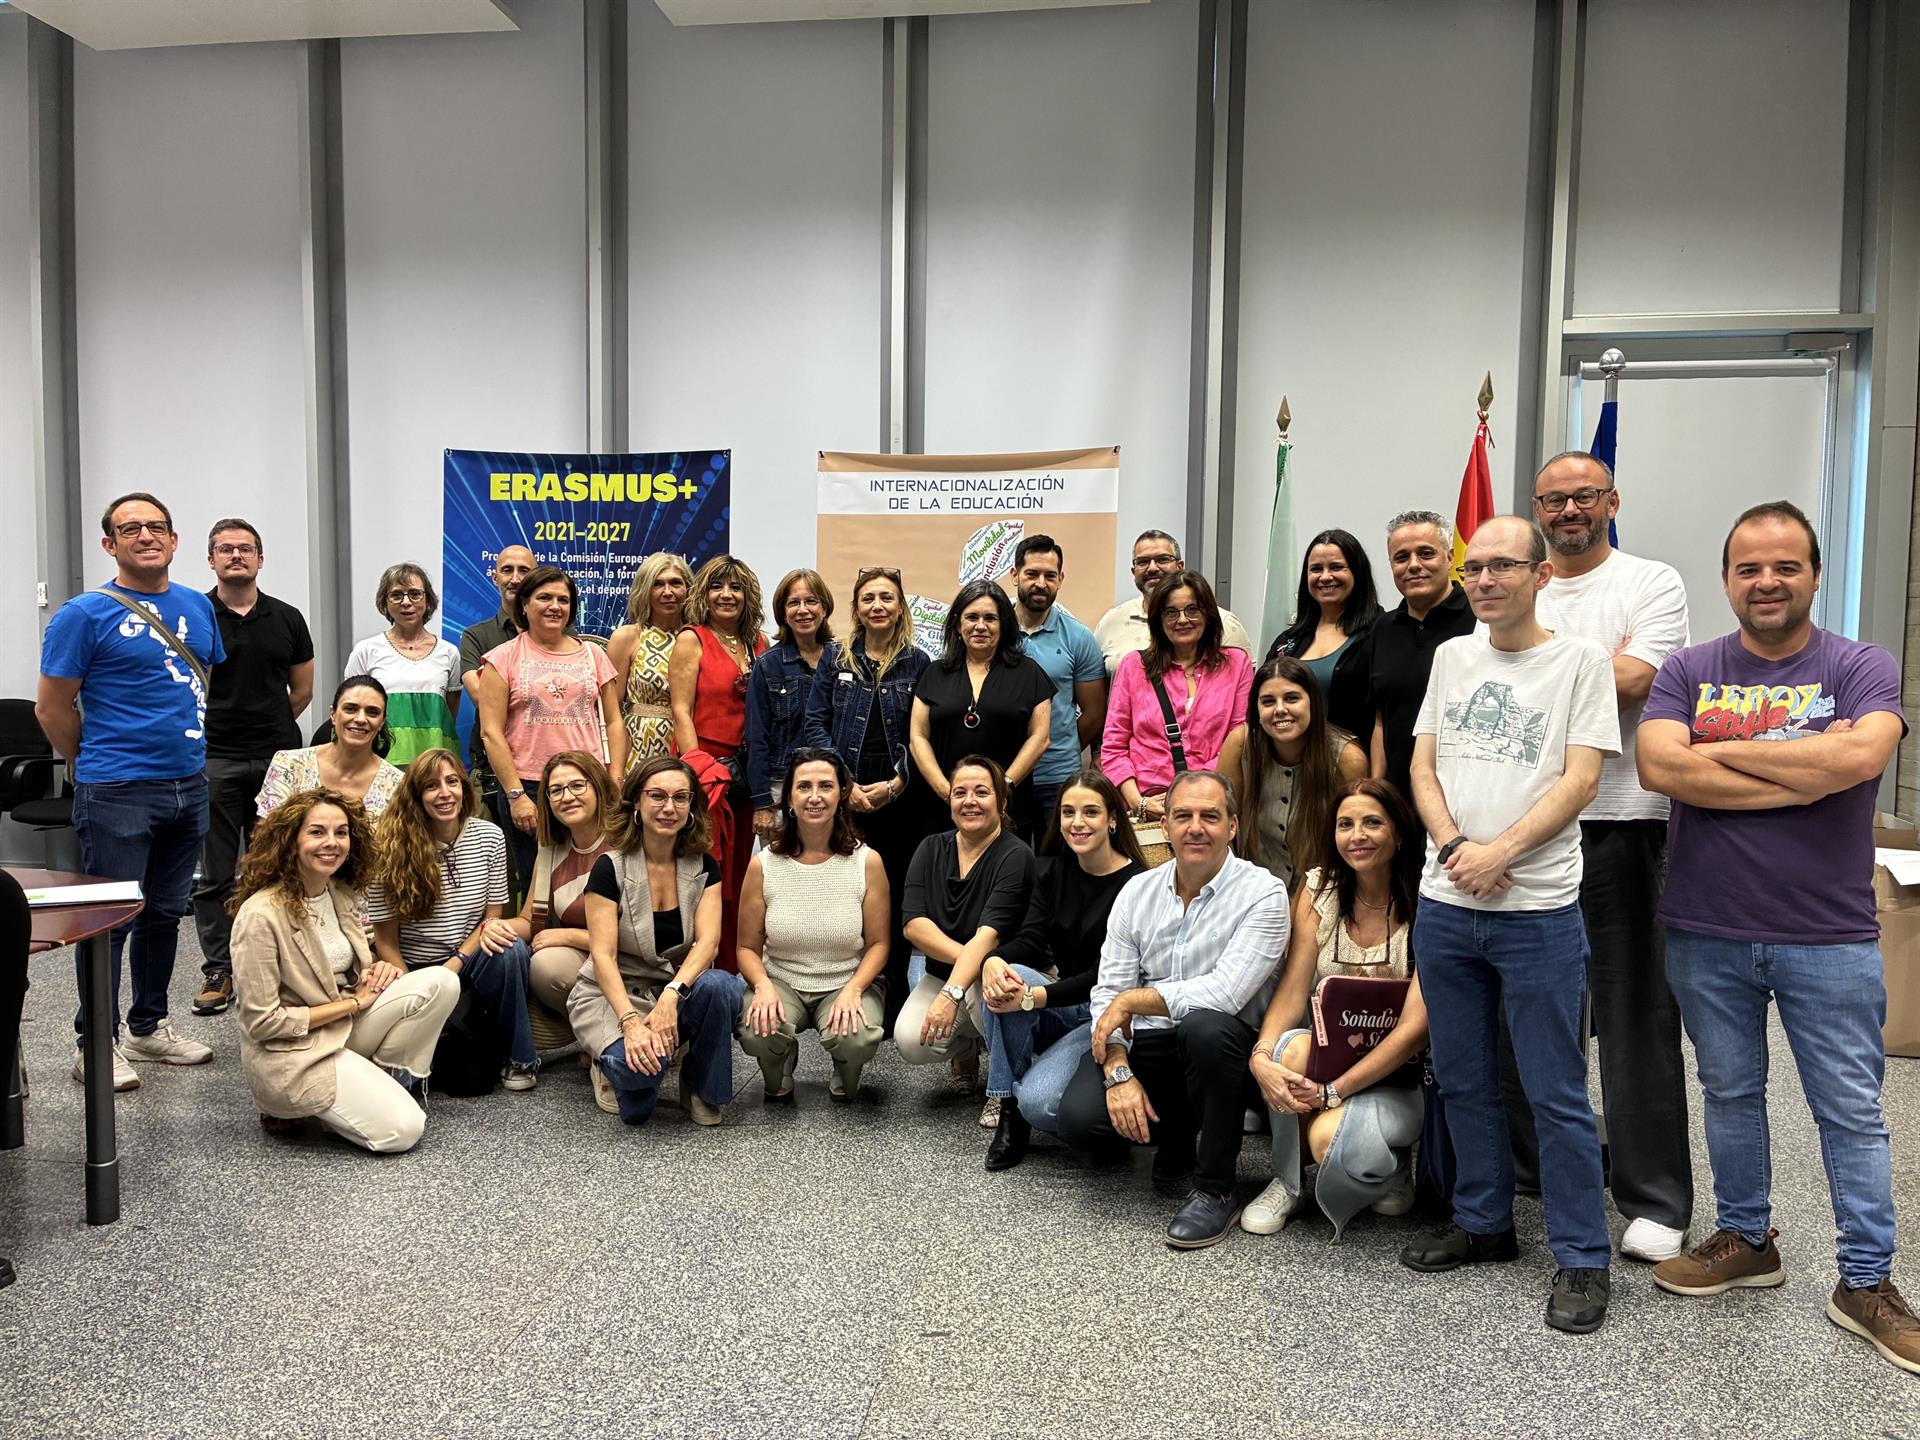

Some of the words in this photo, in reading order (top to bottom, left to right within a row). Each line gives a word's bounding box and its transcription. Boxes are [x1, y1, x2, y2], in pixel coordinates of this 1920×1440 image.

[489, 472, 698, 503] ERASMUS+
[870, 474, 1065, 492] INTERNACIONALIZACIÓN
[888, 497, 910, 510] DE
[919, 497, 941, 510] LA
[951, 493, 1044, 510] EDUCACIÓN
[534, 521, 631, 542] 2021-2027
[966, 522, 1006, 566] Movilidad
[534, 551, 545, 562] de
[548, 551, 558, 562] la
[560, 551, 605, 563] Comisión
[983, 541, 1006, 581] nclusión
[605, 568, 614, 579] la
[586, 584, 595, 594] el
[597, 583, 632, 597] deport
[1695, 682, 1823, 719] LEROY
